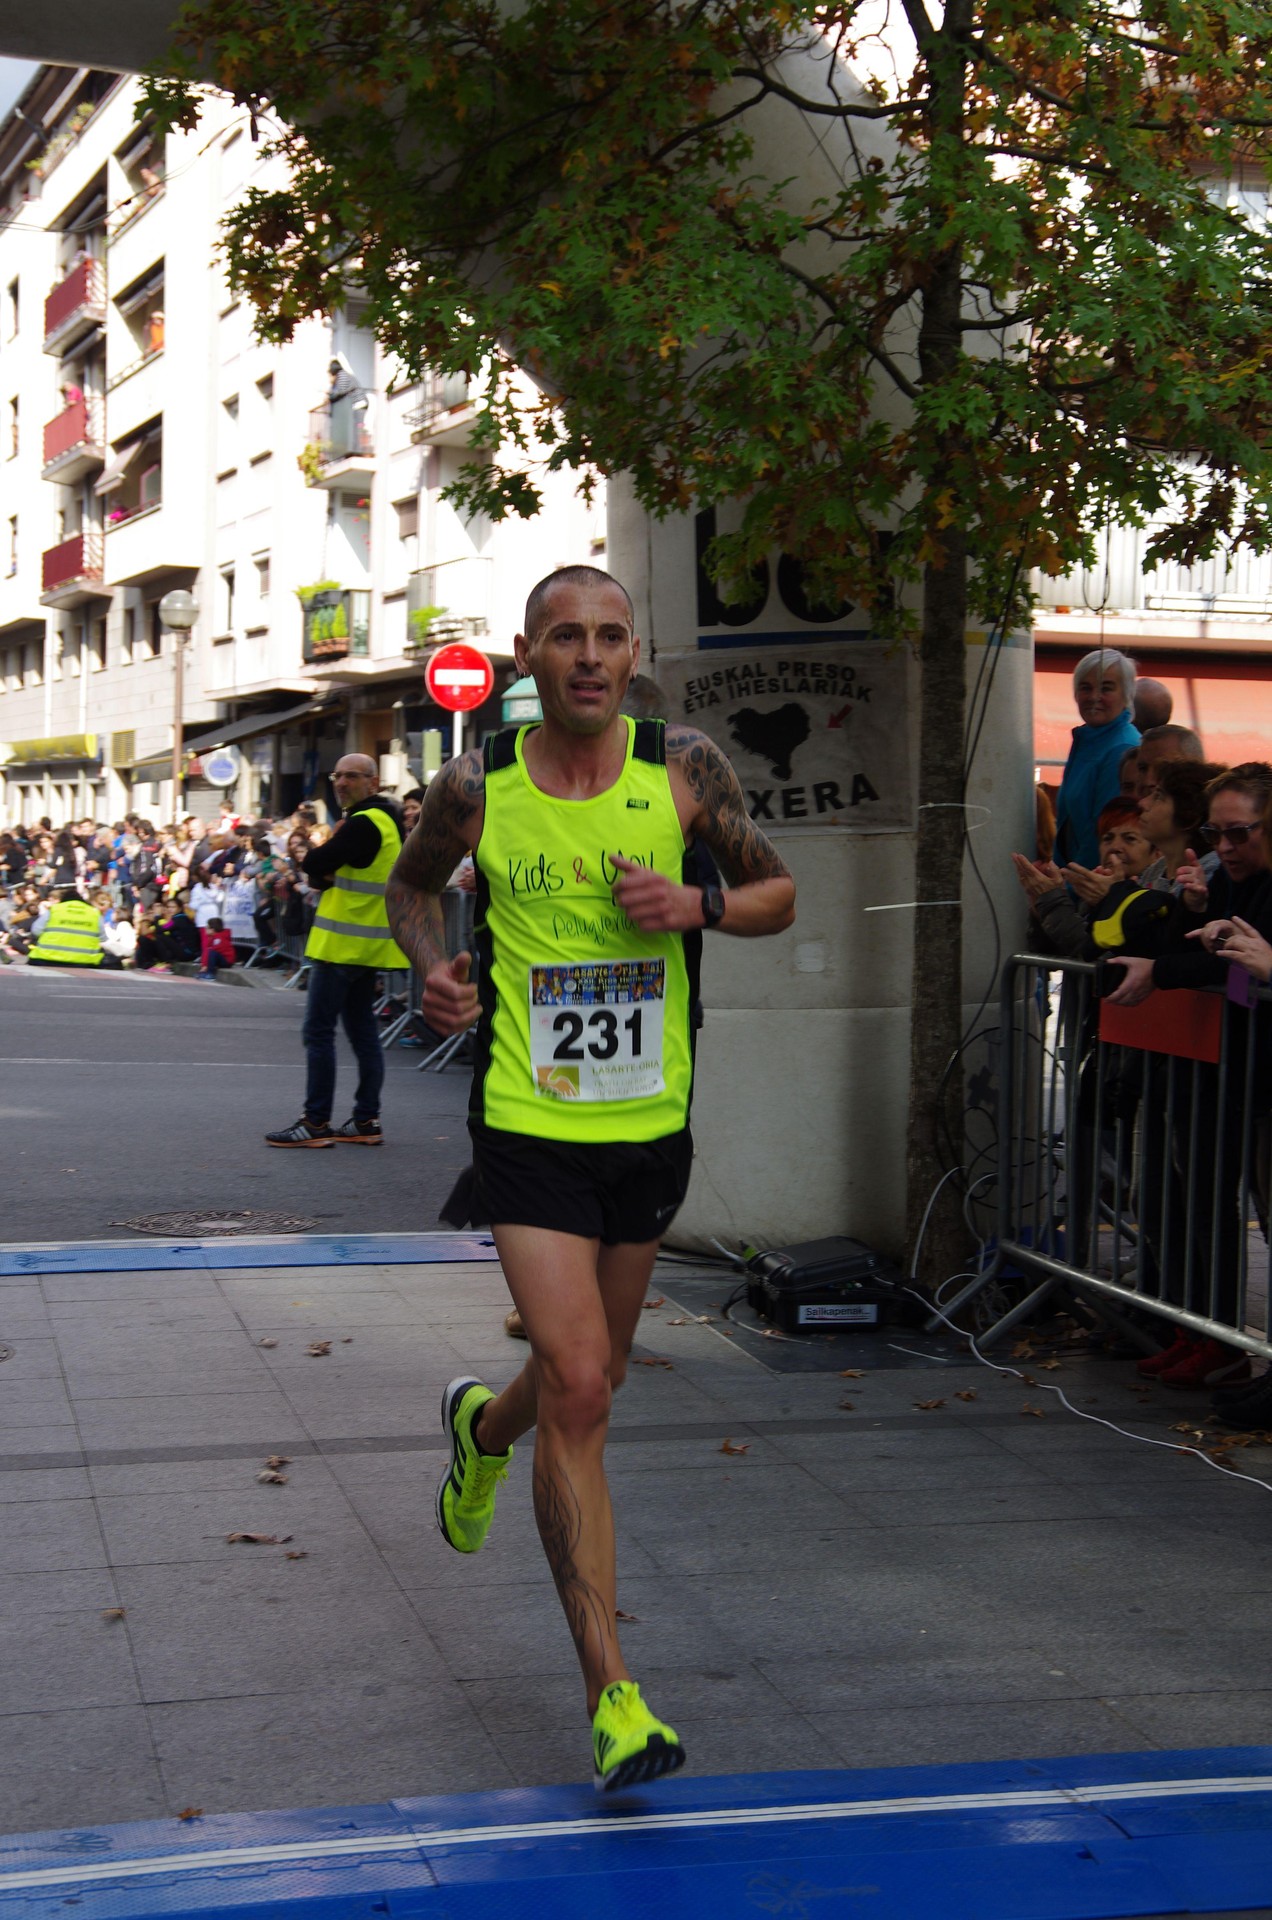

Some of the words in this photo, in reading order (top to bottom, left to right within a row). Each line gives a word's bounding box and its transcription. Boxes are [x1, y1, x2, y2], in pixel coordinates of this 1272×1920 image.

[684, 691, 721, 714] ETA
[729, 678, 873, 703] IHESLARIAK
[685, 662, 768, 696] EUSKAL
[778, 661, 856, 682] PRESO
[748, 772, 880, 820] XERA
[508, 852, 564, 897] Kids
[572, 856, 592, 885] &
[553, 1008, 642, 1060] 231
